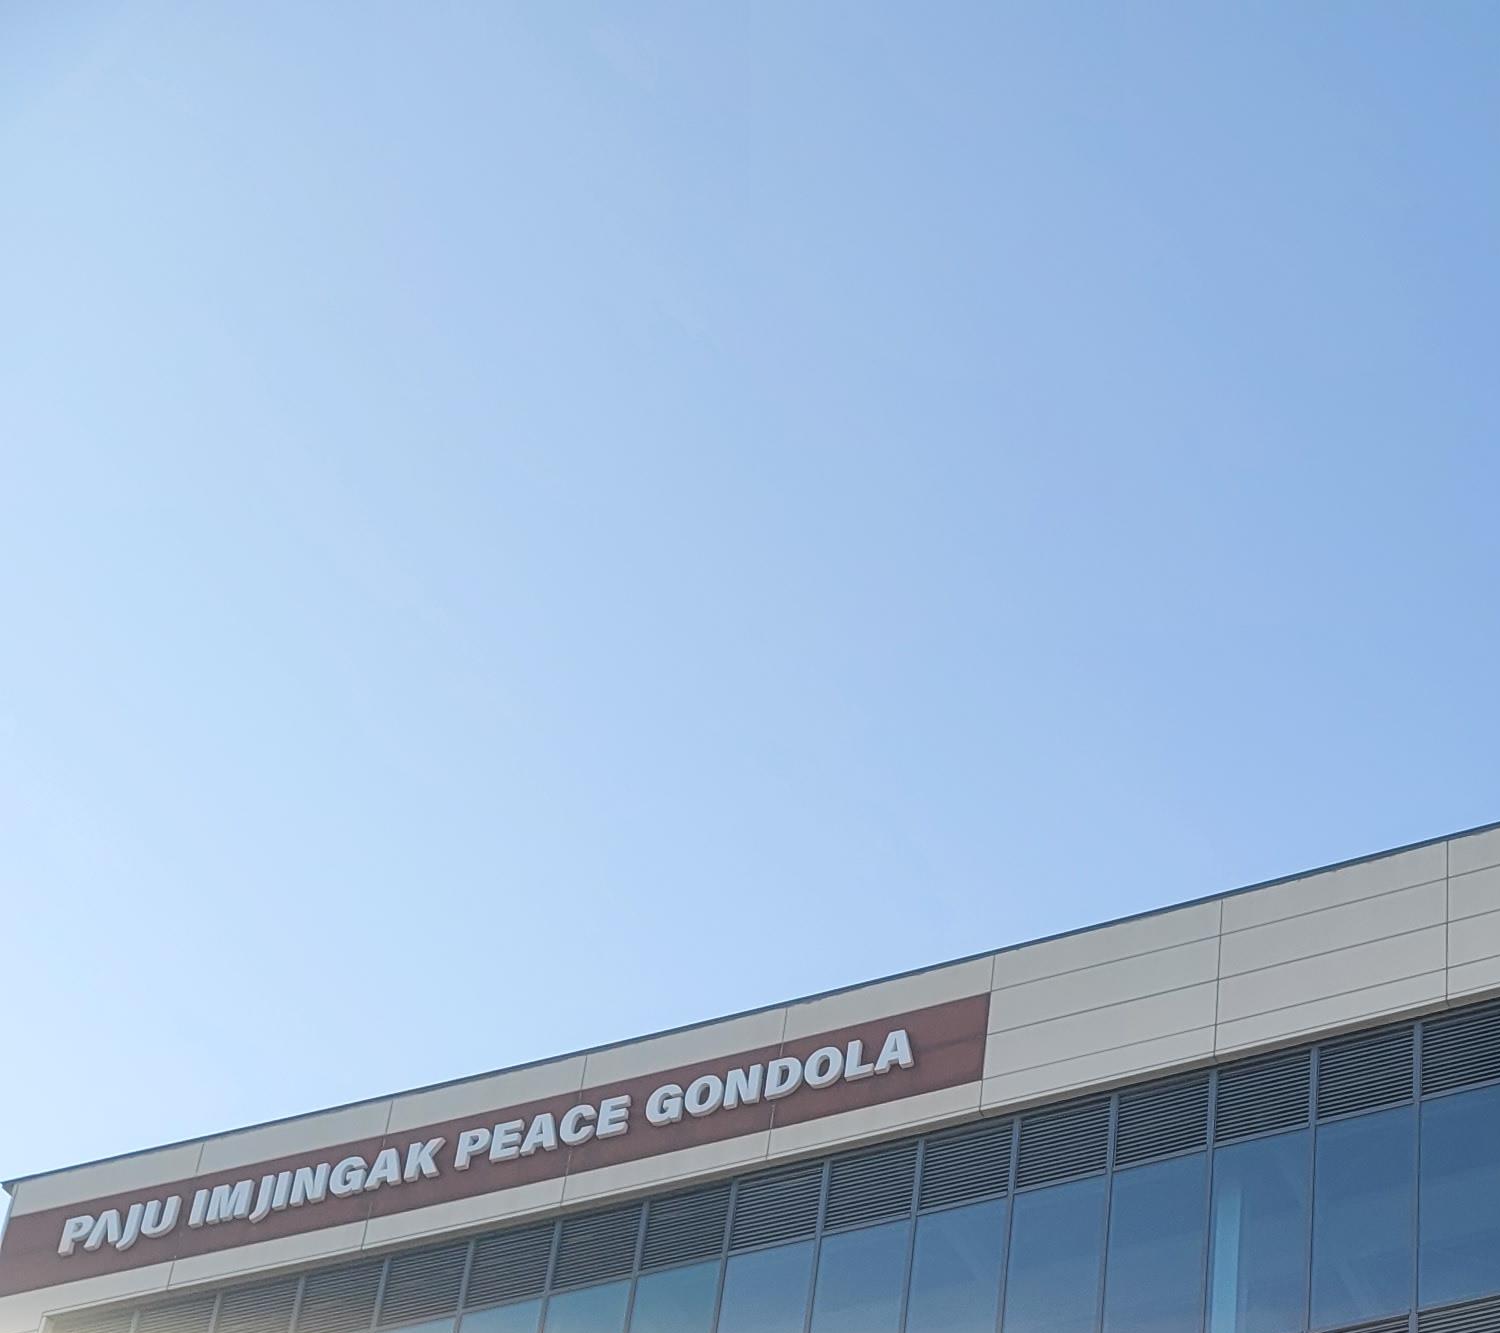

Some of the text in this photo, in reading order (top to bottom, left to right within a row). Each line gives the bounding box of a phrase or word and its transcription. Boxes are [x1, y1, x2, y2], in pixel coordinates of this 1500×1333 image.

[58, 1028, 915, 1256] PAJU IMJINGAK PEACE GONDOLA
